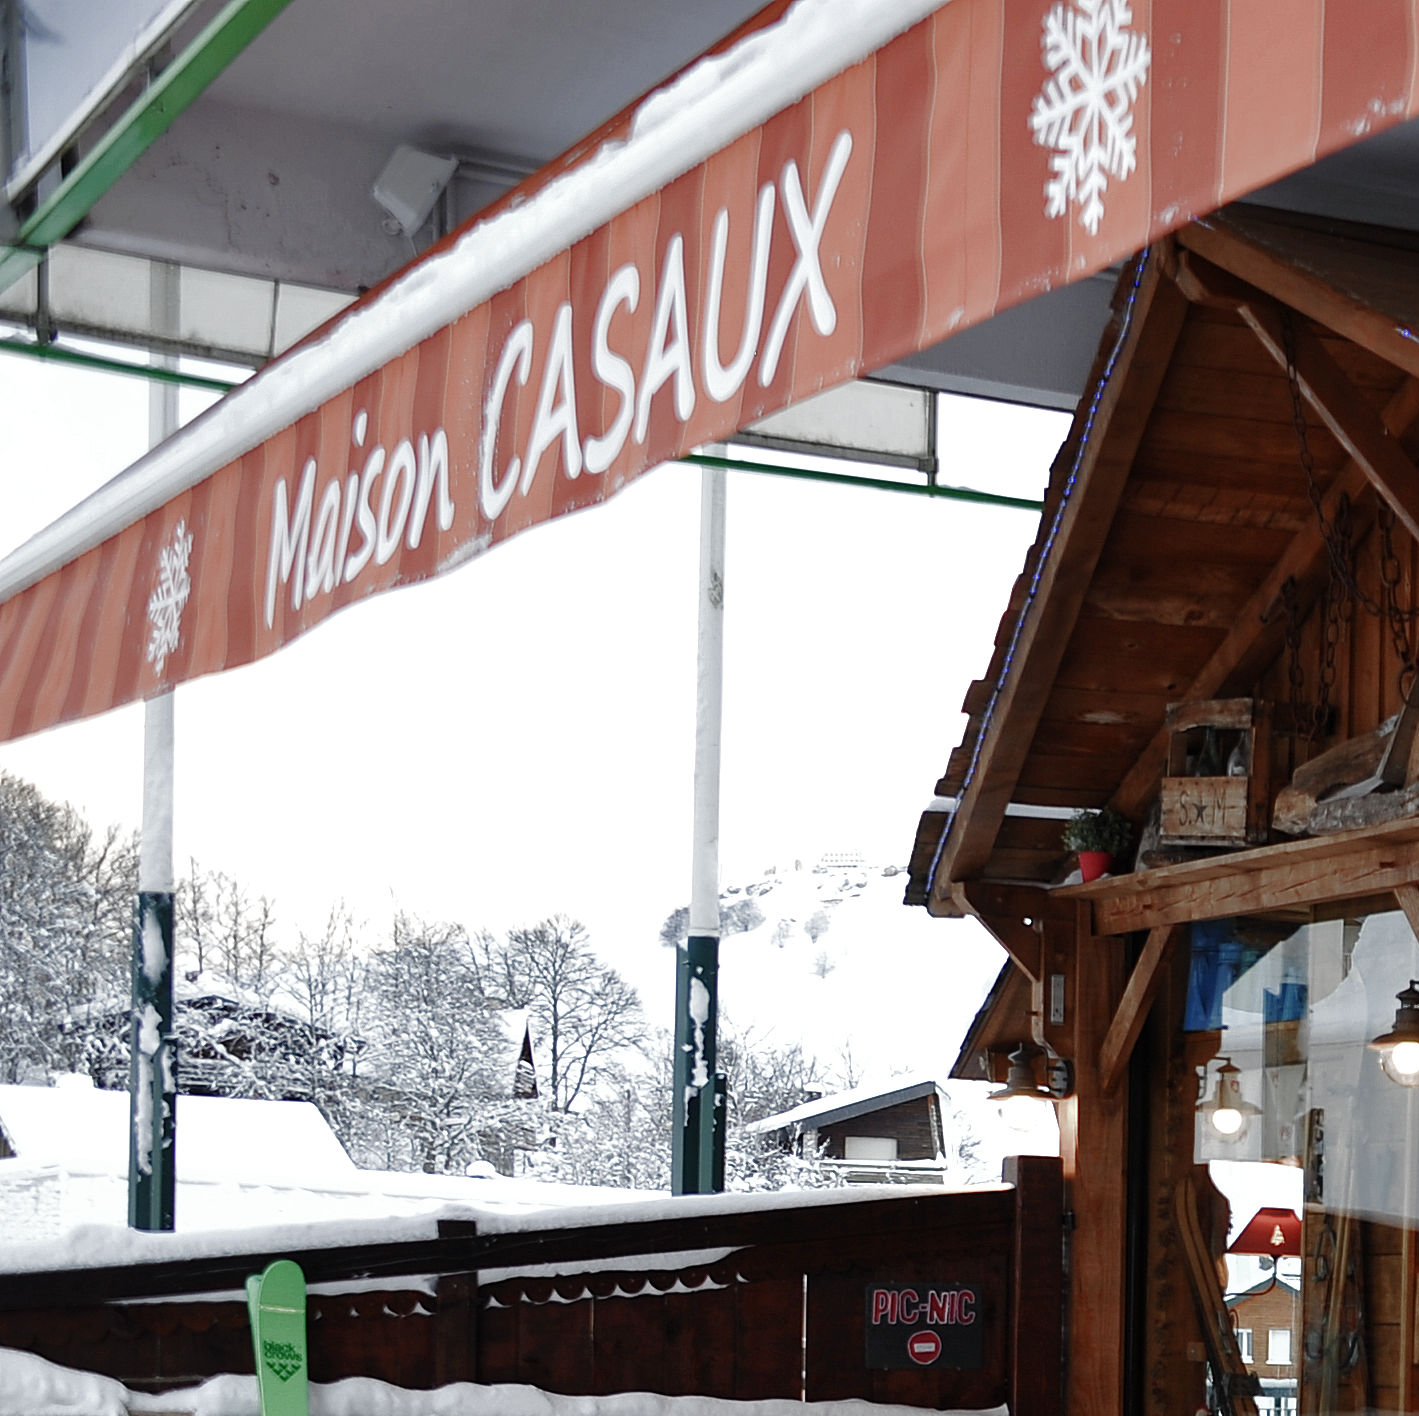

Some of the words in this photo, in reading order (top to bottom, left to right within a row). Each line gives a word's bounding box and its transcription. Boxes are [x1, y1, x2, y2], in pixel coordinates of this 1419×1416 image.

[265, 408, 455, 630] Maison
[480, 130, 853, 520] CASAUX
[872, 1288, 976, 1325] PIC-NIC
